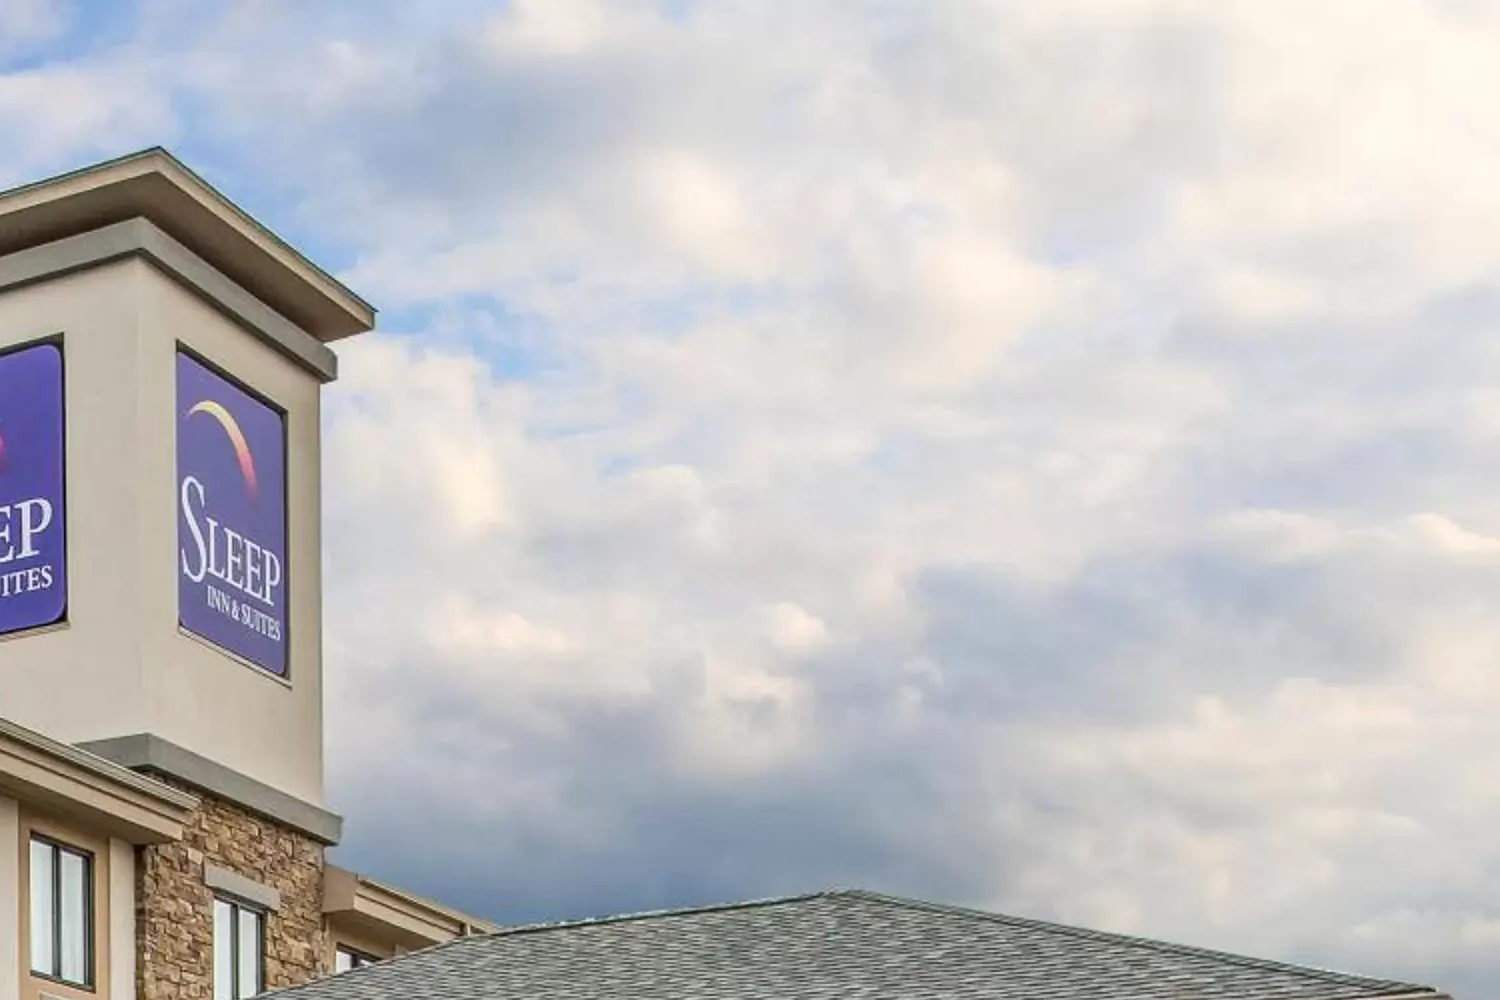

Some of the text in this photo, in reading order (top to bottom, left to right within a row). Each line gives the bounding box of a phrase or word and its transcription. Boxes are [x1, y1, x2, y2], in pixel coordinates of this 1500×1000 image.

[181, 475, 281, 607] SLEEP
[207, 584, 281, 641] INN & SUITES
